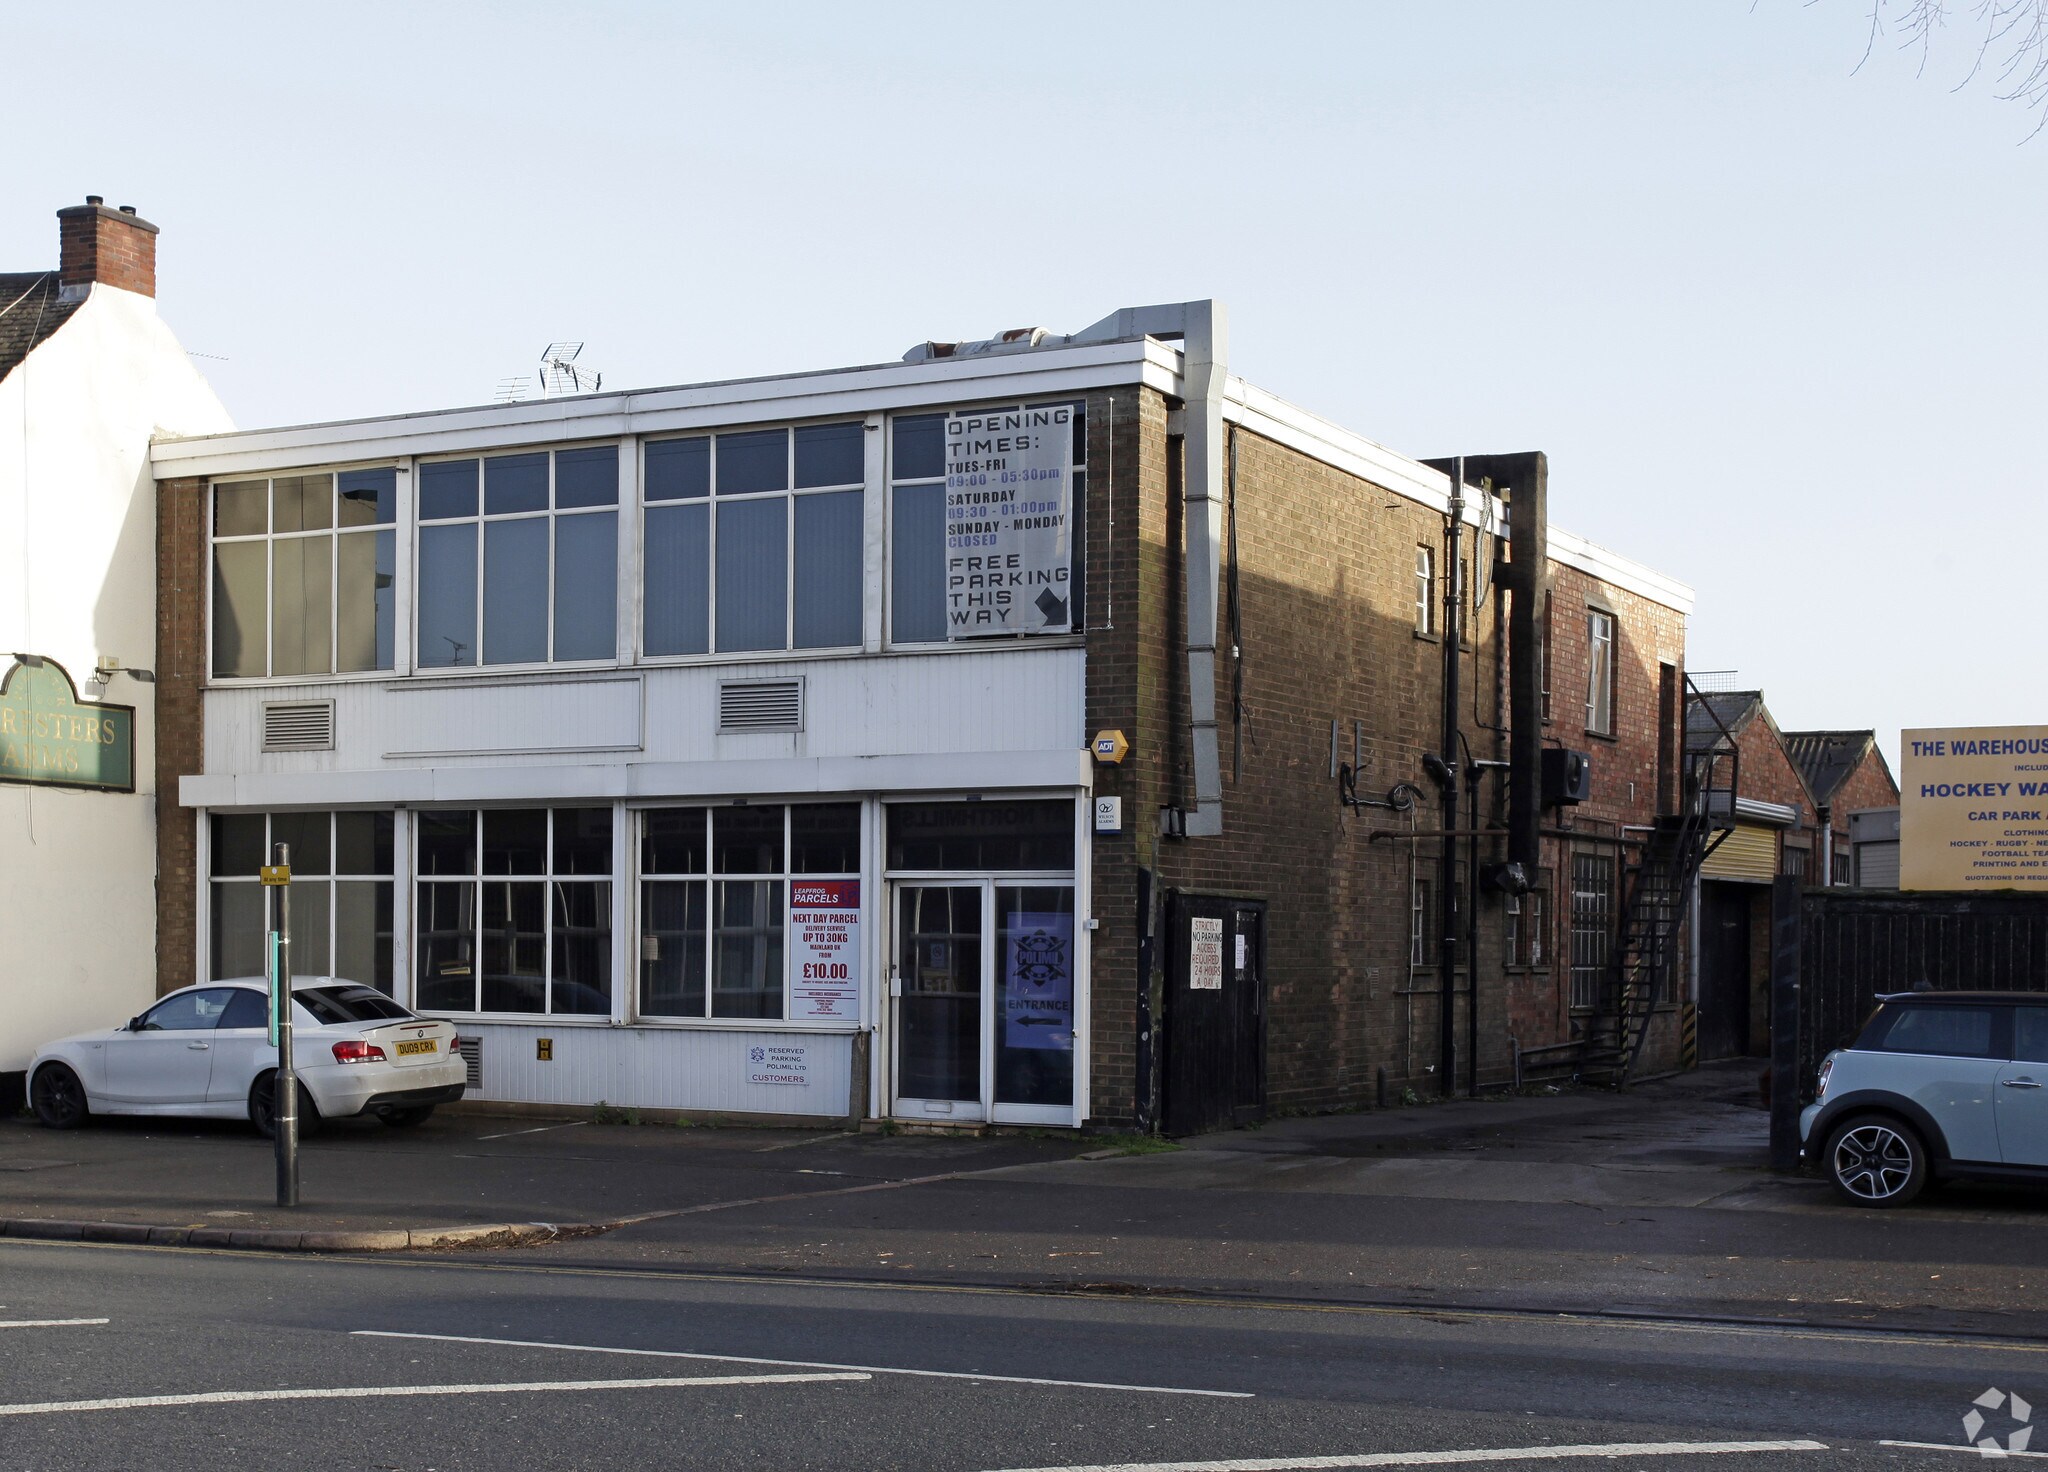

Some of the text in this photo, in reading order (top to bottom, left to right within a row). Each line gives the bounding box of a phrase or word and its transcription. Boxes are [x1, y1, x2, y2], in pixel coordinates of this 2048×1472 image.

[948, 409, 1069, 435] OPENING
[948, 435, 1040, 457] TIMES:
[948, 458, 1006, 475] TUES-FRI
[948, 473, 987, 488] 09:00
[1001, 468, 1060, 485] 05:30pm
[948, 489, 1016, 506] SATURDAY
[948, 505, 987, 520] 09:30
[1001, 500, 1058, 517] 01:00pm
[948, 520, 1000, 536] SUNDAY
[1013, 514, 1065, 532] MONDAY
[948, 533, 997, 548] CLOSED
[949, 554, 1021, 573] FREE
[949, 567, 1069, 590] PARKING
[949, 590, 1012, 608] THIS
[950, 608, 1012, 625] WAY
[1098, 743, 1114, 751] ADT
[1911, 738, 2048, 757] THE WAREHOUS
[1, 742, 78, 773] ARMS
[1921, 782, 2011, 797] HOCKEY
[1968, 811, 1998, 821] CAR
[2002, 811, 2041, 820] PARK
[794, 894, 839, 903] PARCELS
[793, 914, 858, 924] NEXT DAY PARCEL
[803, 933, 848, 943] UP TO 30KG
[1192, 932, 1200, 941] NO
[803, 962, 848, 979] £10.00
[1009, 999, 1069, 1011] ENTRANCE
[398, 1041, 435, 1054] DU09 CRX
[752, 1074, 805, 1083] CUSTOMERS
